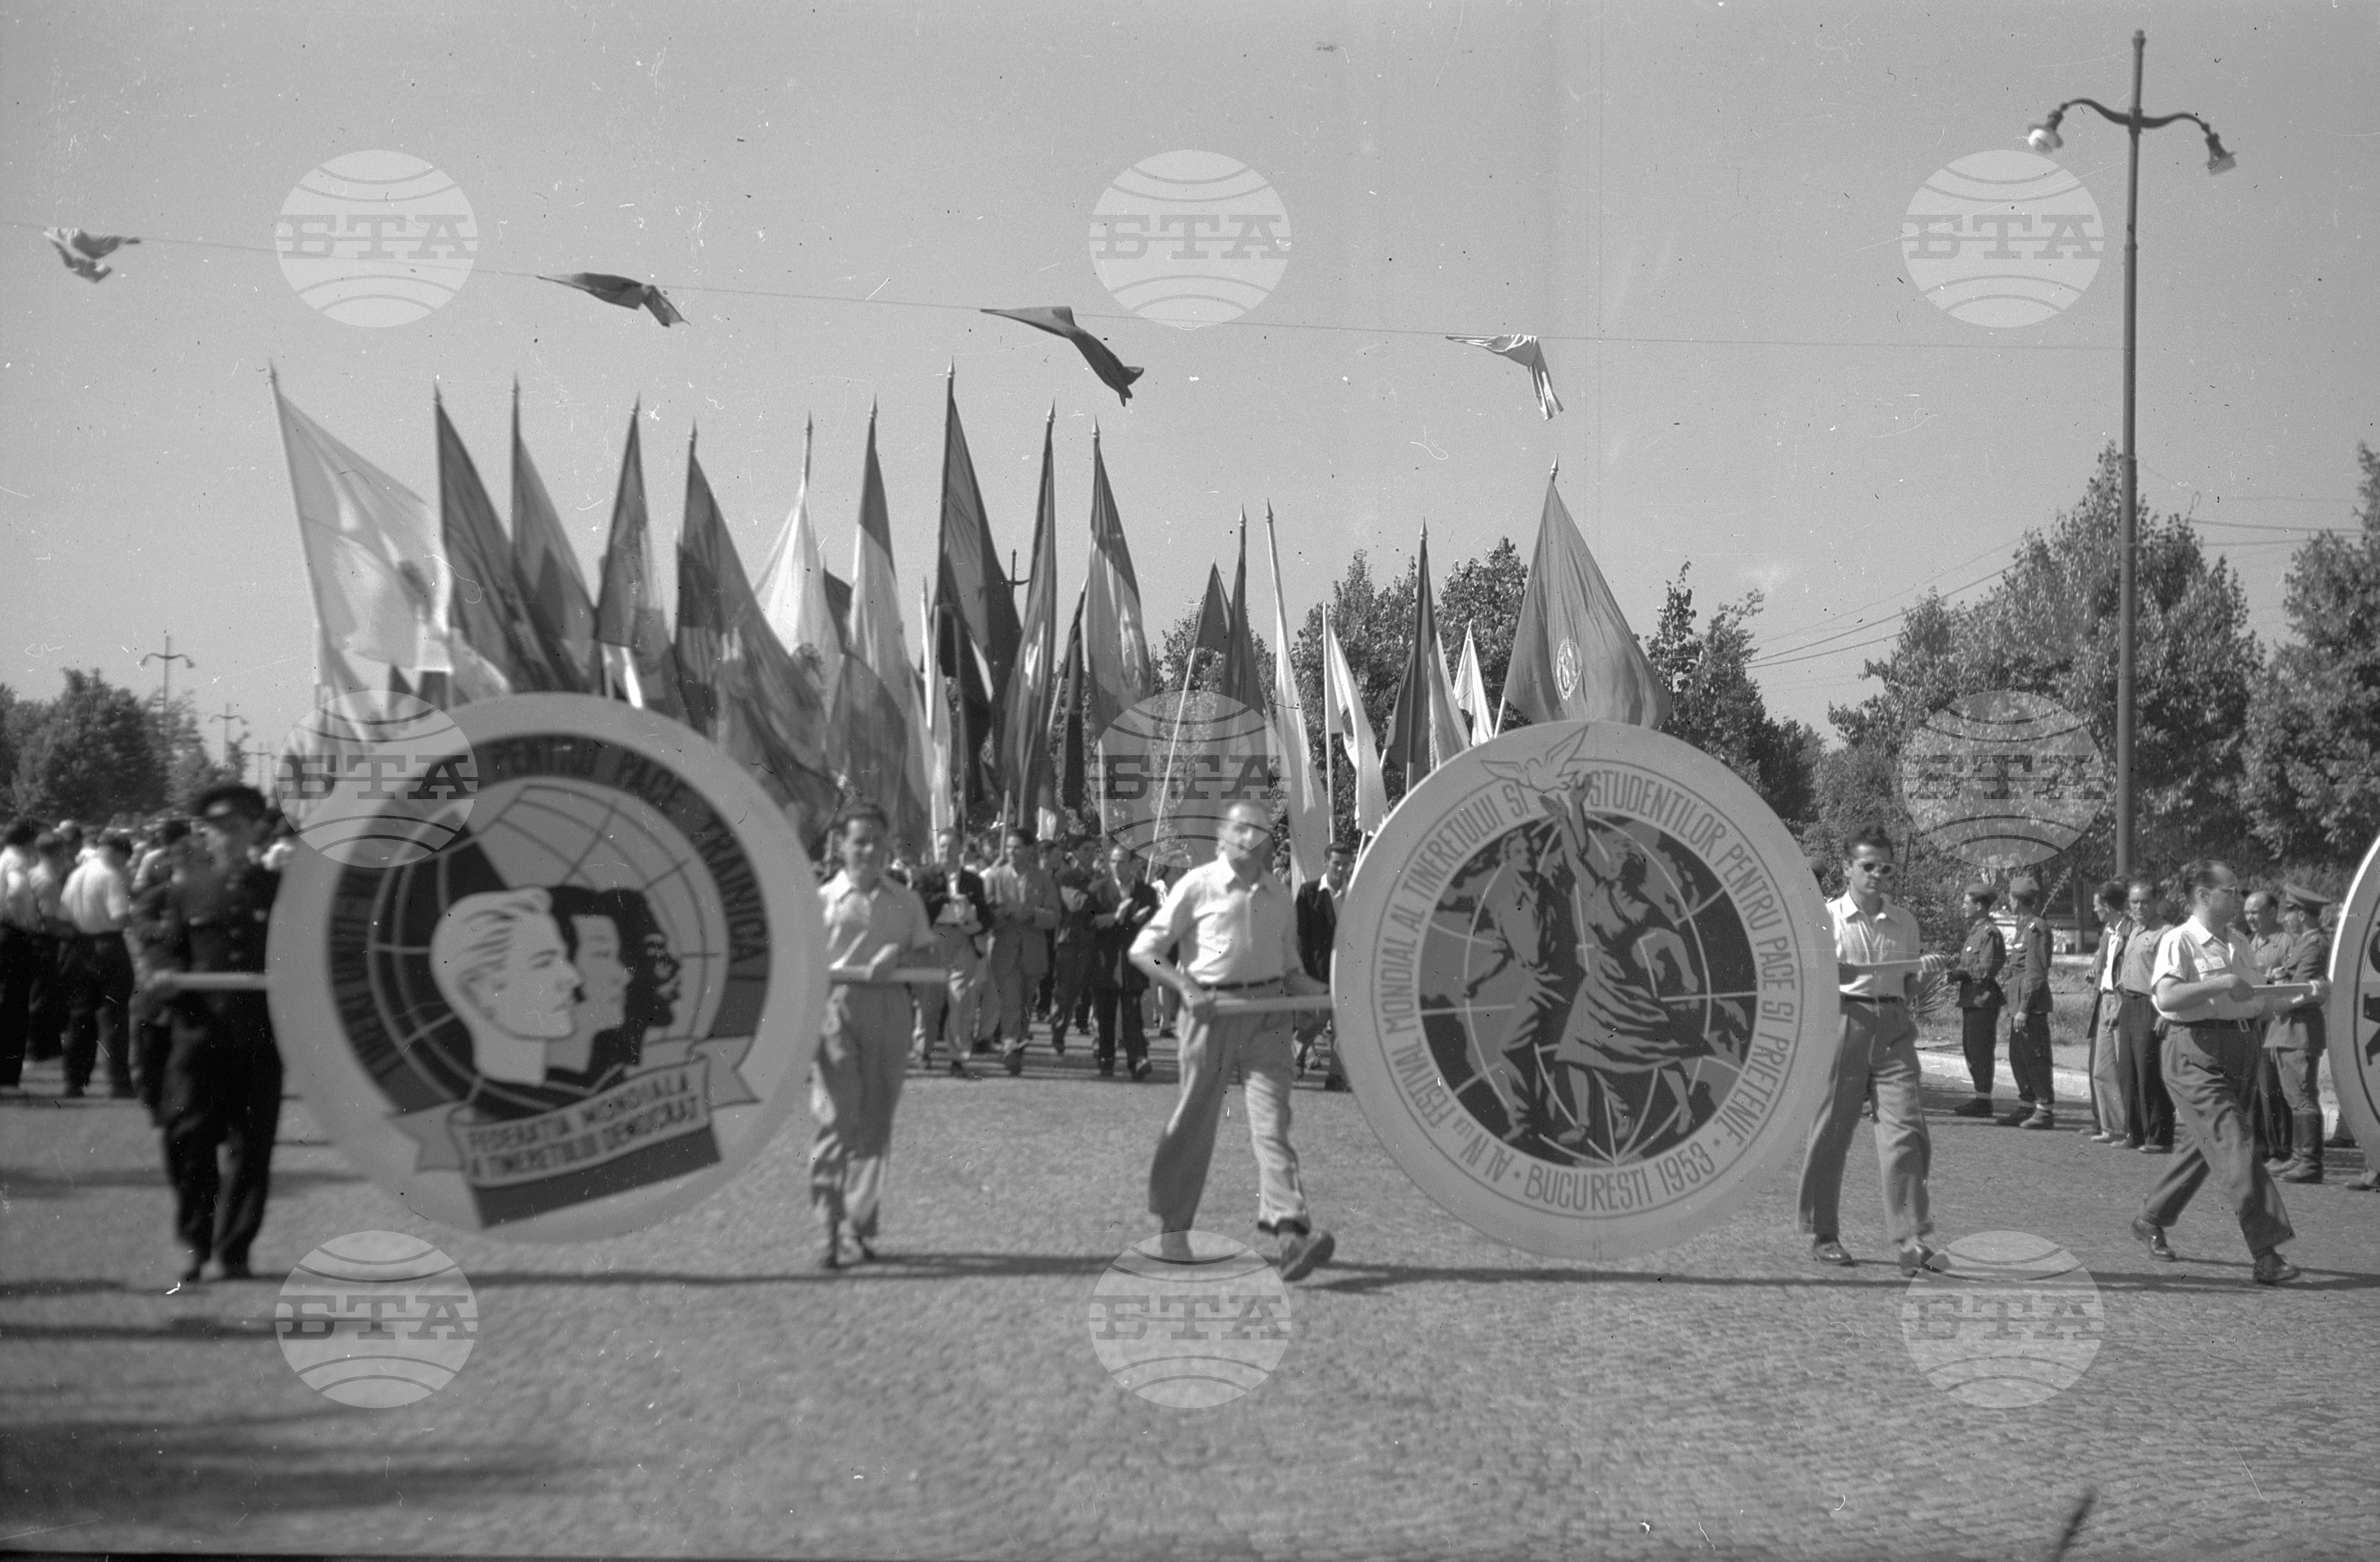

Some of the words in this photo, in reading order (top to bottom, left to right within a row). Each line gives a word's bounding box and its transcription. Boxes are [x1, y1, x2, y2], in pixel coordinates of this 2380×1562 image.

[1401, 794, 1505, 901] TINERETULUI
[1589, 771, 1726, 857] STUDENTILOR
[1389, 904, 1426, 933] AL
[1714, 843, 1783, 931] PENTRU
[1380, 938, 1418, 1034] MONDIAL
[1756, 936, 1795, 991] PACE
[1760, 1000, 1795, 1023] SI
[1392, 1038, 1457, 1128] FESTIVAL
[1713, 1032, 1789, 1147] PRIETENIE
[1485, 1144, 1515, 1183] AL
[1524, 1163, 1653, 1212] BUCURESTI
[1656, 1141, 1716, 1196] 1953
